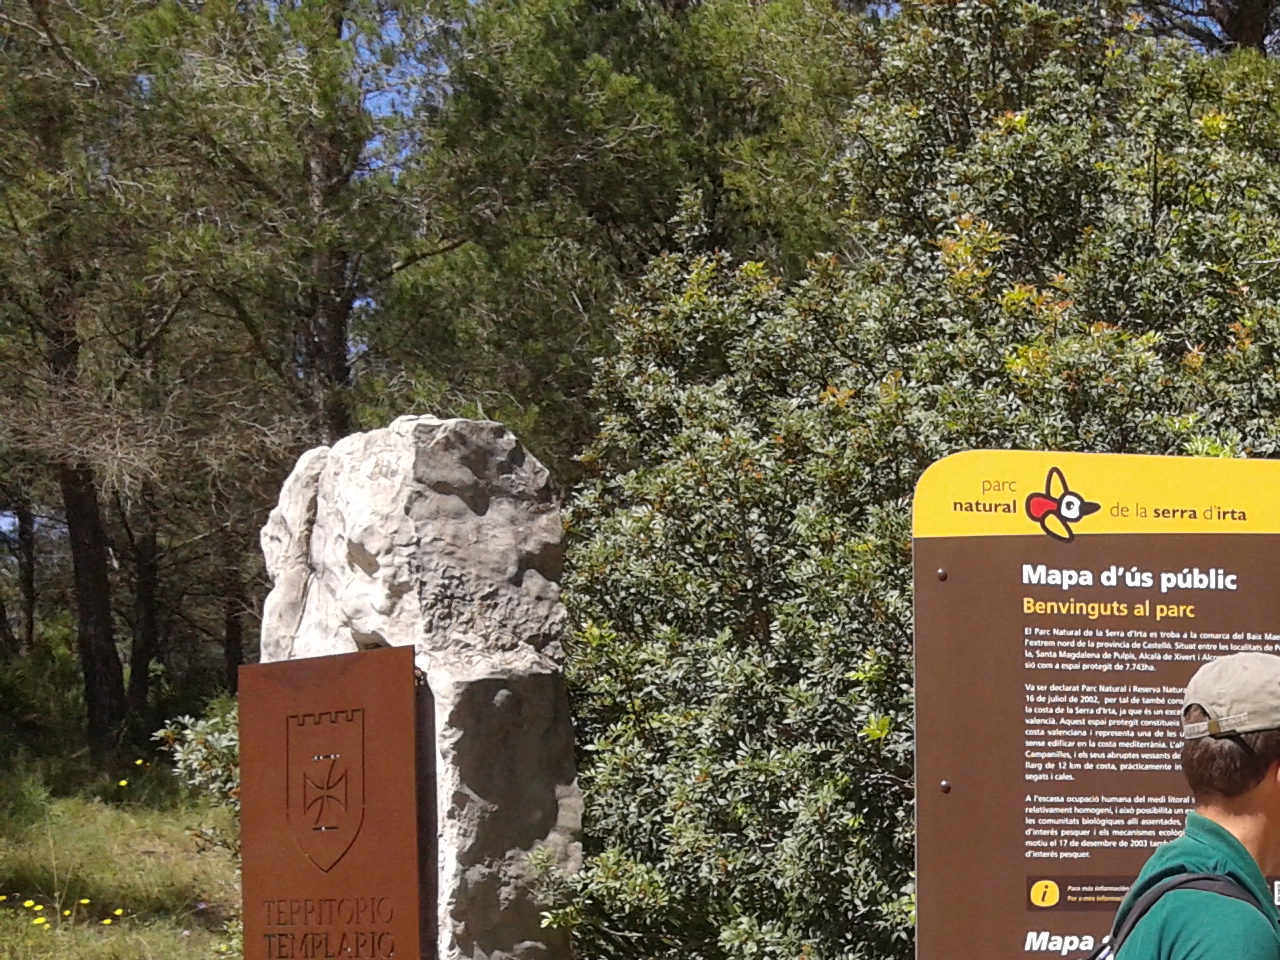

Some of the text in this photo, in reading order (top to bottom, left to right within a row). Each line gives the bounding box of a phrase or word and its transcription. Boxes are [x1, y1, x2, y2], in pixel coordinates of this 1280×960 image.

[982, 478, 1017, 496] parc
[952, 499, 1017, 514] natural
[1110, 502, 1247, 522] de la serra d'irta
[1022, 564, 1238, 592] Mapa d'ús públic
[1023, 597, 1196, 621] Benvinguts al parc
[1053, 628, 1081, 636] Natural
[1105, 629, 1125, 637] Serra
[1127, 630, 1147, 638] d'Irta
[1232, 632, 1244, 640] del
[1025, 639, 1055, 647] l'extrem
[1174, 642, 1196, 650] Situat
[1219, 643, 1229, 651] les
[1230, 644, 1263, 652] localitats
[1035, 650, 1057, 658] Santa
[1059, 651, 1100, 660] Magdalena
[1082, 663, 1112, 672] protegit
[1049, 684, 1079, 692] declarat
[1081, 684, 1097, 692] Parc
[1048, 695, 1067, 704] juliol
[1130, 696, 1140, 704] de
[1055, 706, 1065, 714] de
[1066, 706, 1073, 714] la
[1119, 708, 1126, 716] ja
[1059, 718, 1086, 726] Aquest
[1108, 719, 1139, 727] protegit
[1089, 740, 1096, 748] la
[1078, 751, 1088, 759] els
[1025, 761, 1043, 771] llarg
[1083, 762, 1094, 770] de
[1025, 774, 1049, 782] segats
[1025, 806, 1173, 815] relativament possibilita
[1098, 828, 1109, 836] els
[1049, 839, 1057, 847] el
[1059, 839, 1068, 847] 17
[1069, 839, 1079, 847] de
[263, 932, 395, 959] TEMPLARIO
[1025, 932, 1094, 956] Mapa
